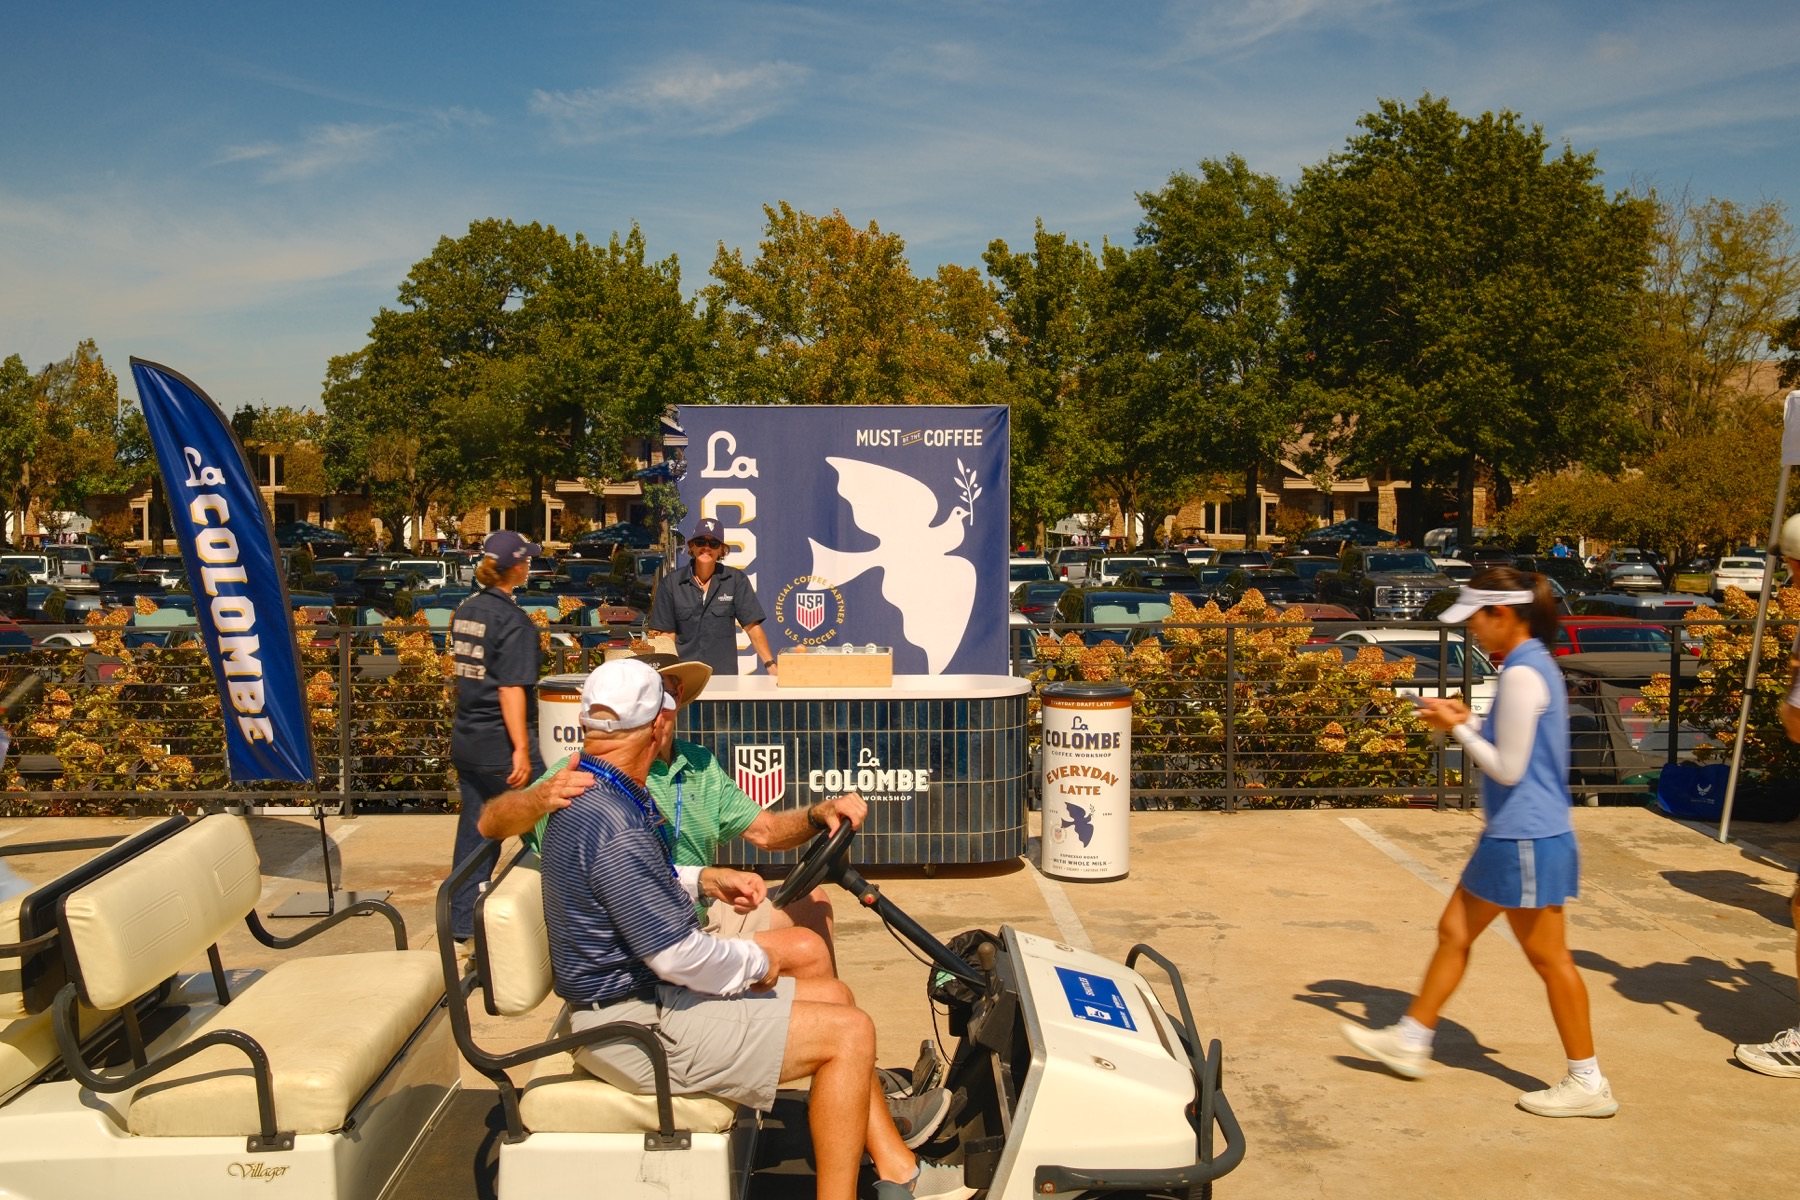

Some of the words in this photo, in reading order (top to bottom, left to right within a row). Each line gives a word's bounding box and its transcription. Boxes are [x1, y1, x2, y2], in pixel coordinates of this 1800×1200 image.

[856, 429, 902, 446] MUST
[923, 429, 983, 446] COFFEE
[700, 430, 759, 478] La
[183, 446, 226, 487] La
[775, 583, 794, 623] OFFICIAL
[828, 583, 846, 624] PARTNER
[797, 594, 823, 610] USA
[189, 492, 274, 746] COLOMBE
[802, 628, 837, 645] SOCCER
[1071, 715, 1089, 731] La
[1045, 728, 1121, 750] COLOMBE
[738, 748, 783, 774] USA
[856, 747, 881, 767] La
[808, 769, 930, 793] COLOMBE
[1046, 765, 1119, 787] EVERYDAY
[1059, 785, 1101, 796] LATTE
[227, 1162, 290, 1183] Villager
